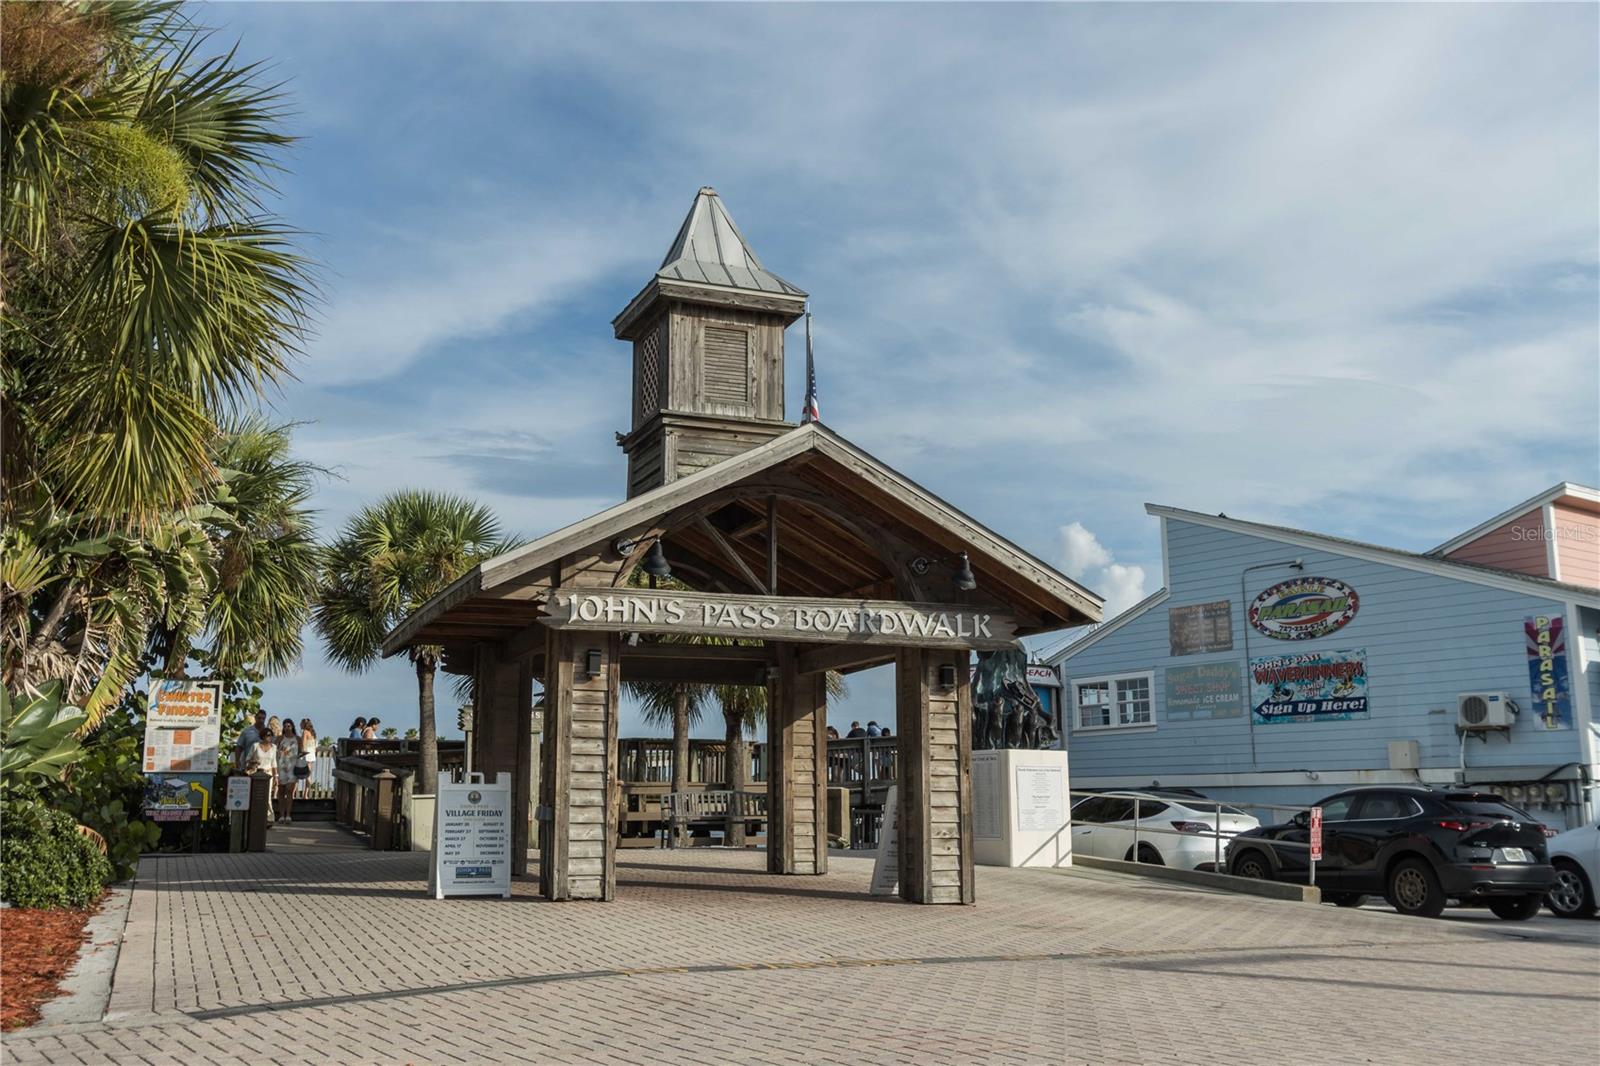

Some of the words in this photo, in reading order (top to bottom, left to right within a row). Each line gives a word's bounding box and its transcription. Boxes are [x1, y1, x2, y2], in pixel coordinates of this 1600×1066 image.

[567, 593, 685, 625] JOHN'S
[701, 603, 781, 630] PASS
[793, 606, 993, 639] BOARDWALK
[1250, 659, 1290, 672] JOHN'S
[1294, 654, 1320, 664] PASS
[1024, 669, 1052, 679] EACH
[1253, 660, 1365, 685] WAVERUNNERS
[1535, 616, 1558, 729] PARASAIL
[1261, 703, 1293, 715] Sign
[1297, 702, 1317, 713] Up
[1321, 699, 1365, 711] Here!
[445, 809, 476, 817] VILLAGE
[477, 809, 503, 817] FRIDAY
